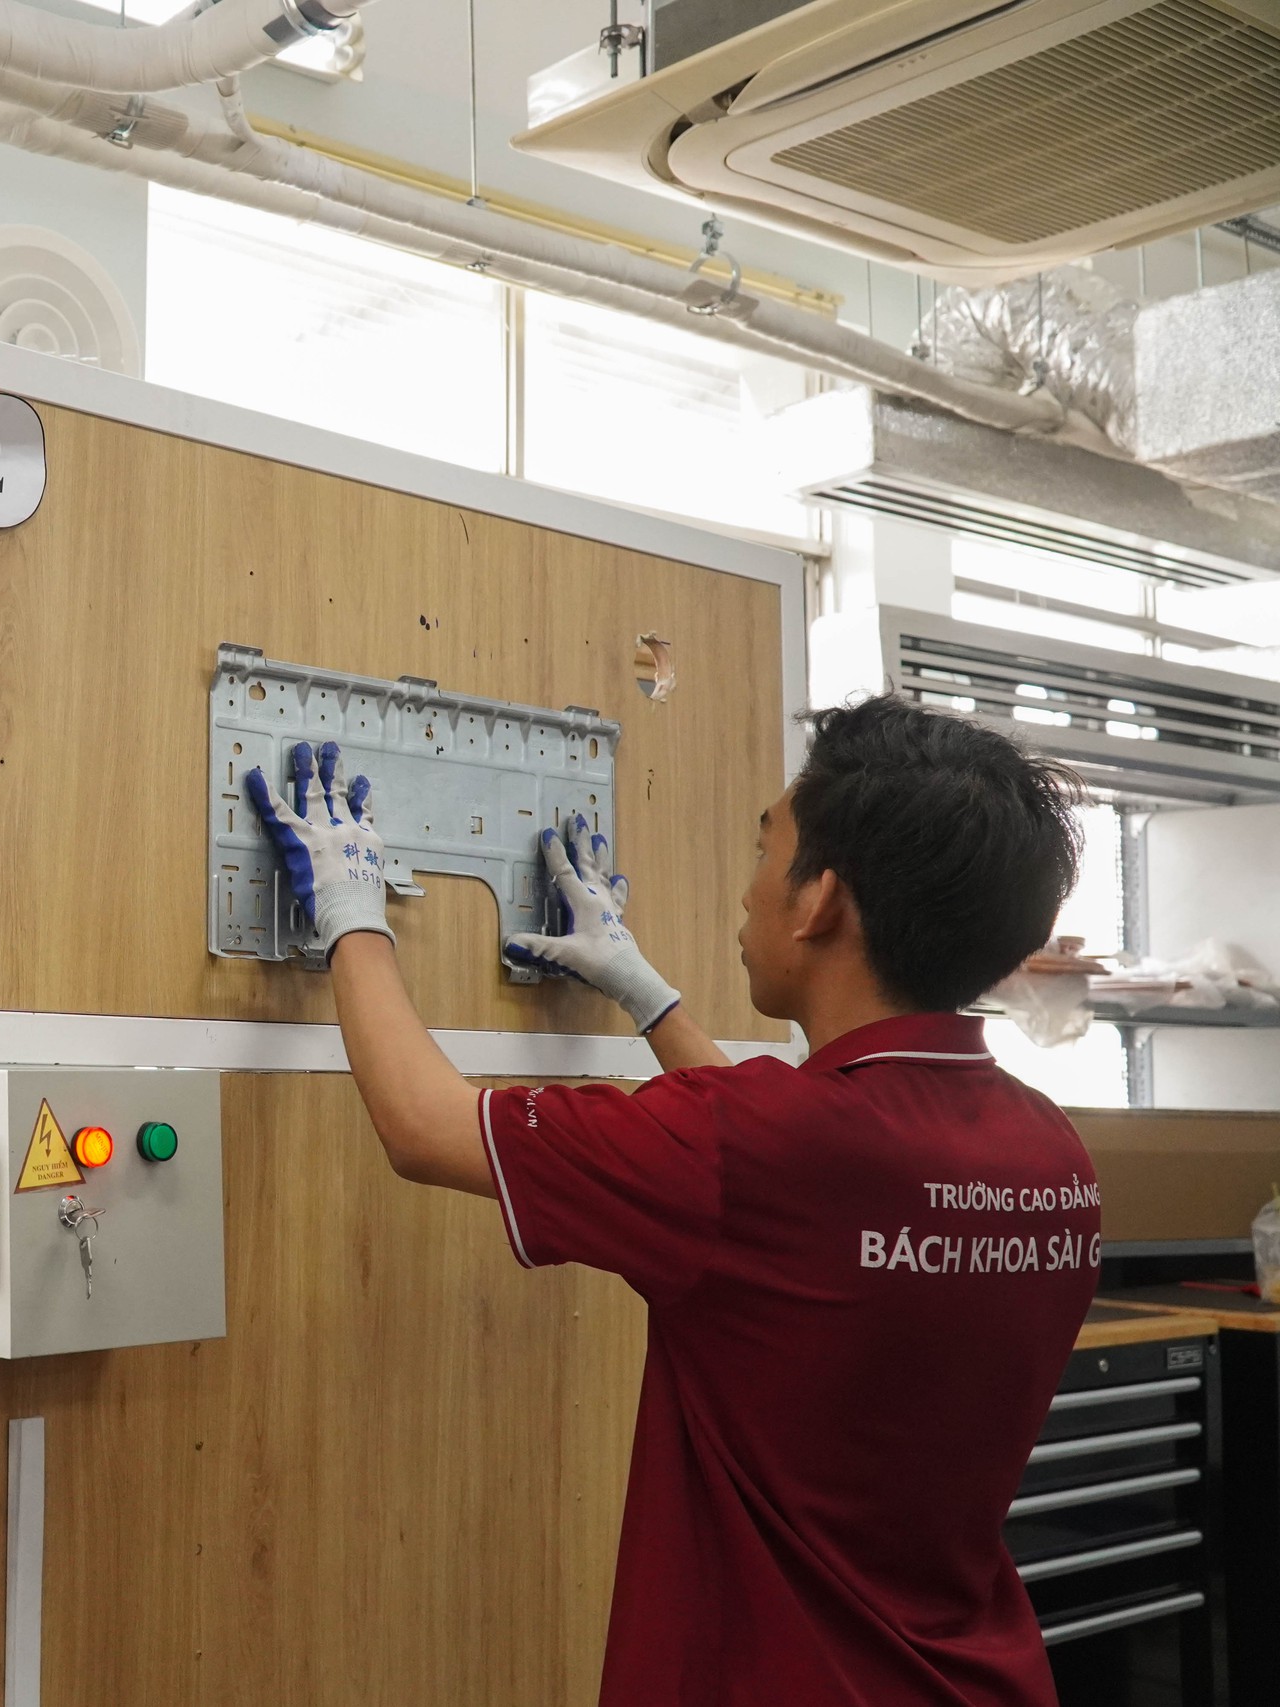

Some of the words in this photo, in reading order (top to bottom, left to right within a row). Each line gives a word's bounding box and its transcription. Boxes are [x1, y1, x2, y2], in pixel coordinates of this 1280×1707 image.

[32, 1163, 50, 1173] NGUY
[37, 1171, 64, 1180] DANGER
[924, 1181, 1014, 1211] TRƯỜNG
[1020, 1188, 1056, 1211] CAO
[860, 1226, 963, 1274] BÁCH
[969, 1236, 1039, 1273] KHOA
[1045, 1228, 1082, 1271] SÀI
